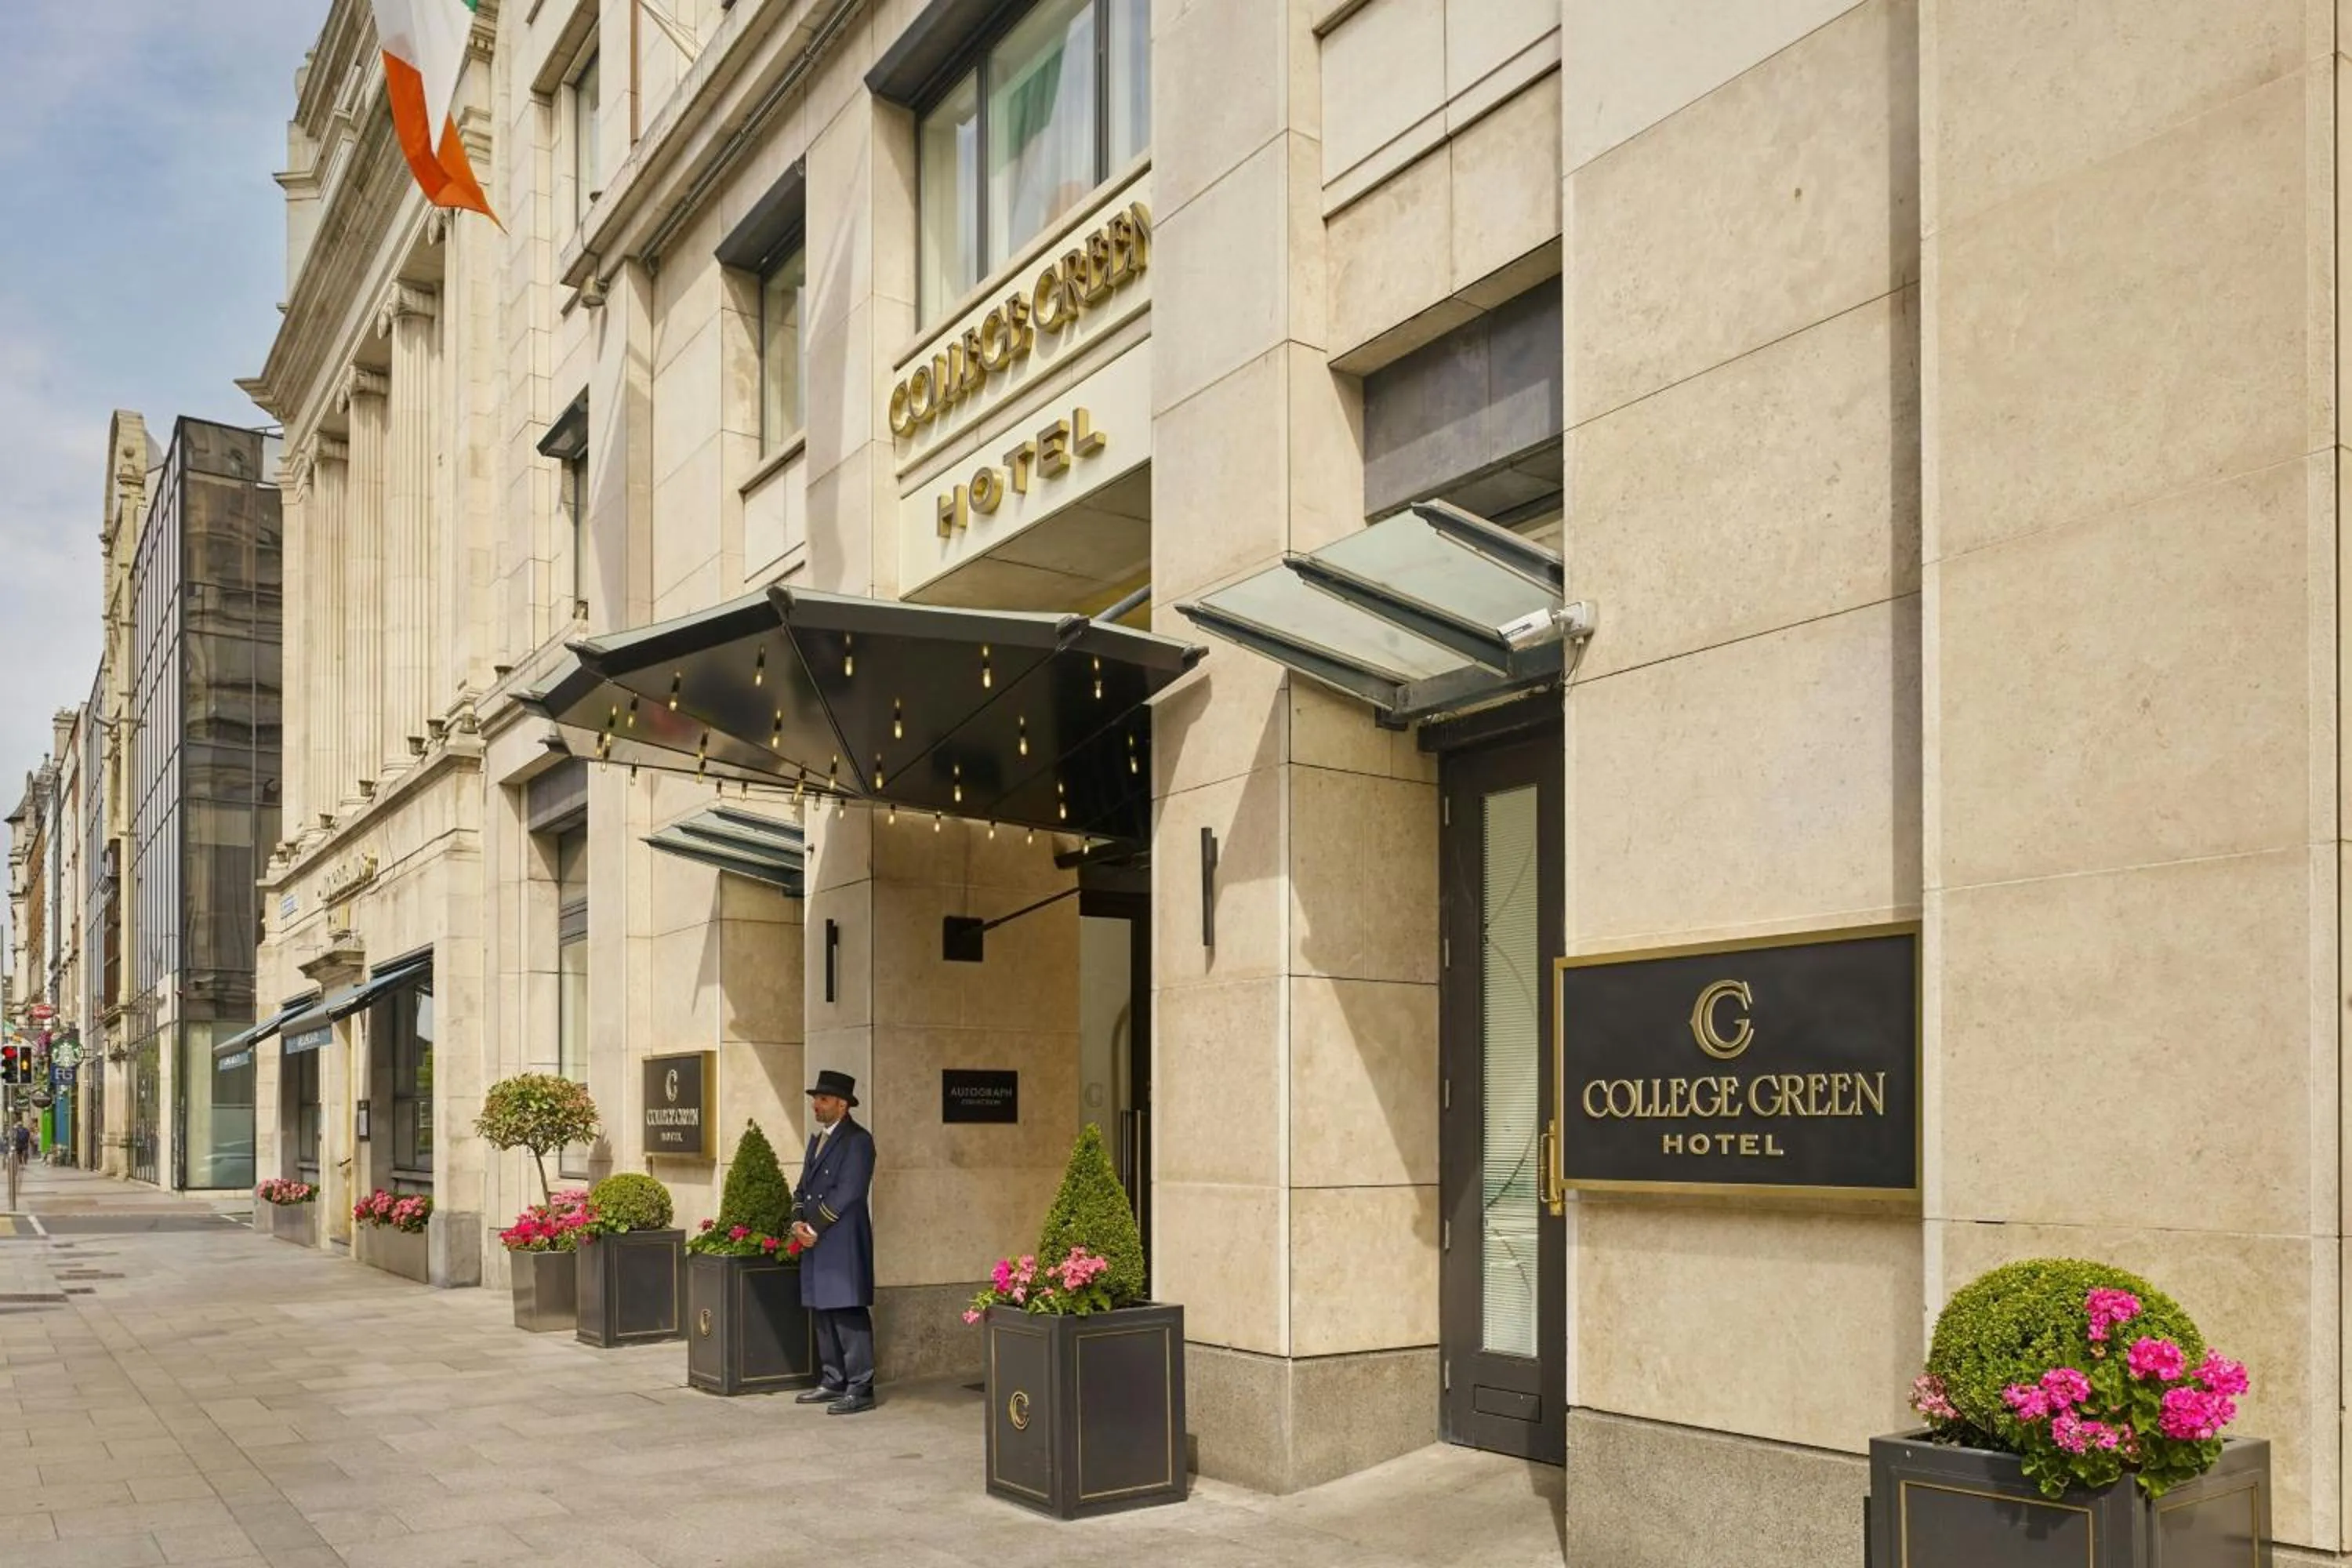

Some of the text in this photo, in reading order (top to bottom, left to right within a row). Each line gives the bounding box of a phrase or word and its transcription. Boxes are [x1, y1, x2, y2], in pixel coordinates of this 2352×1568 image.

[889, 291, 1033, 437] COLLEGE
[937, 407, 1106, 538] HOTEL
[1582, 1072, 1886, 1119] COLLEGE GREEN
[1662, 1134, 1784, 1156] HOTEL
